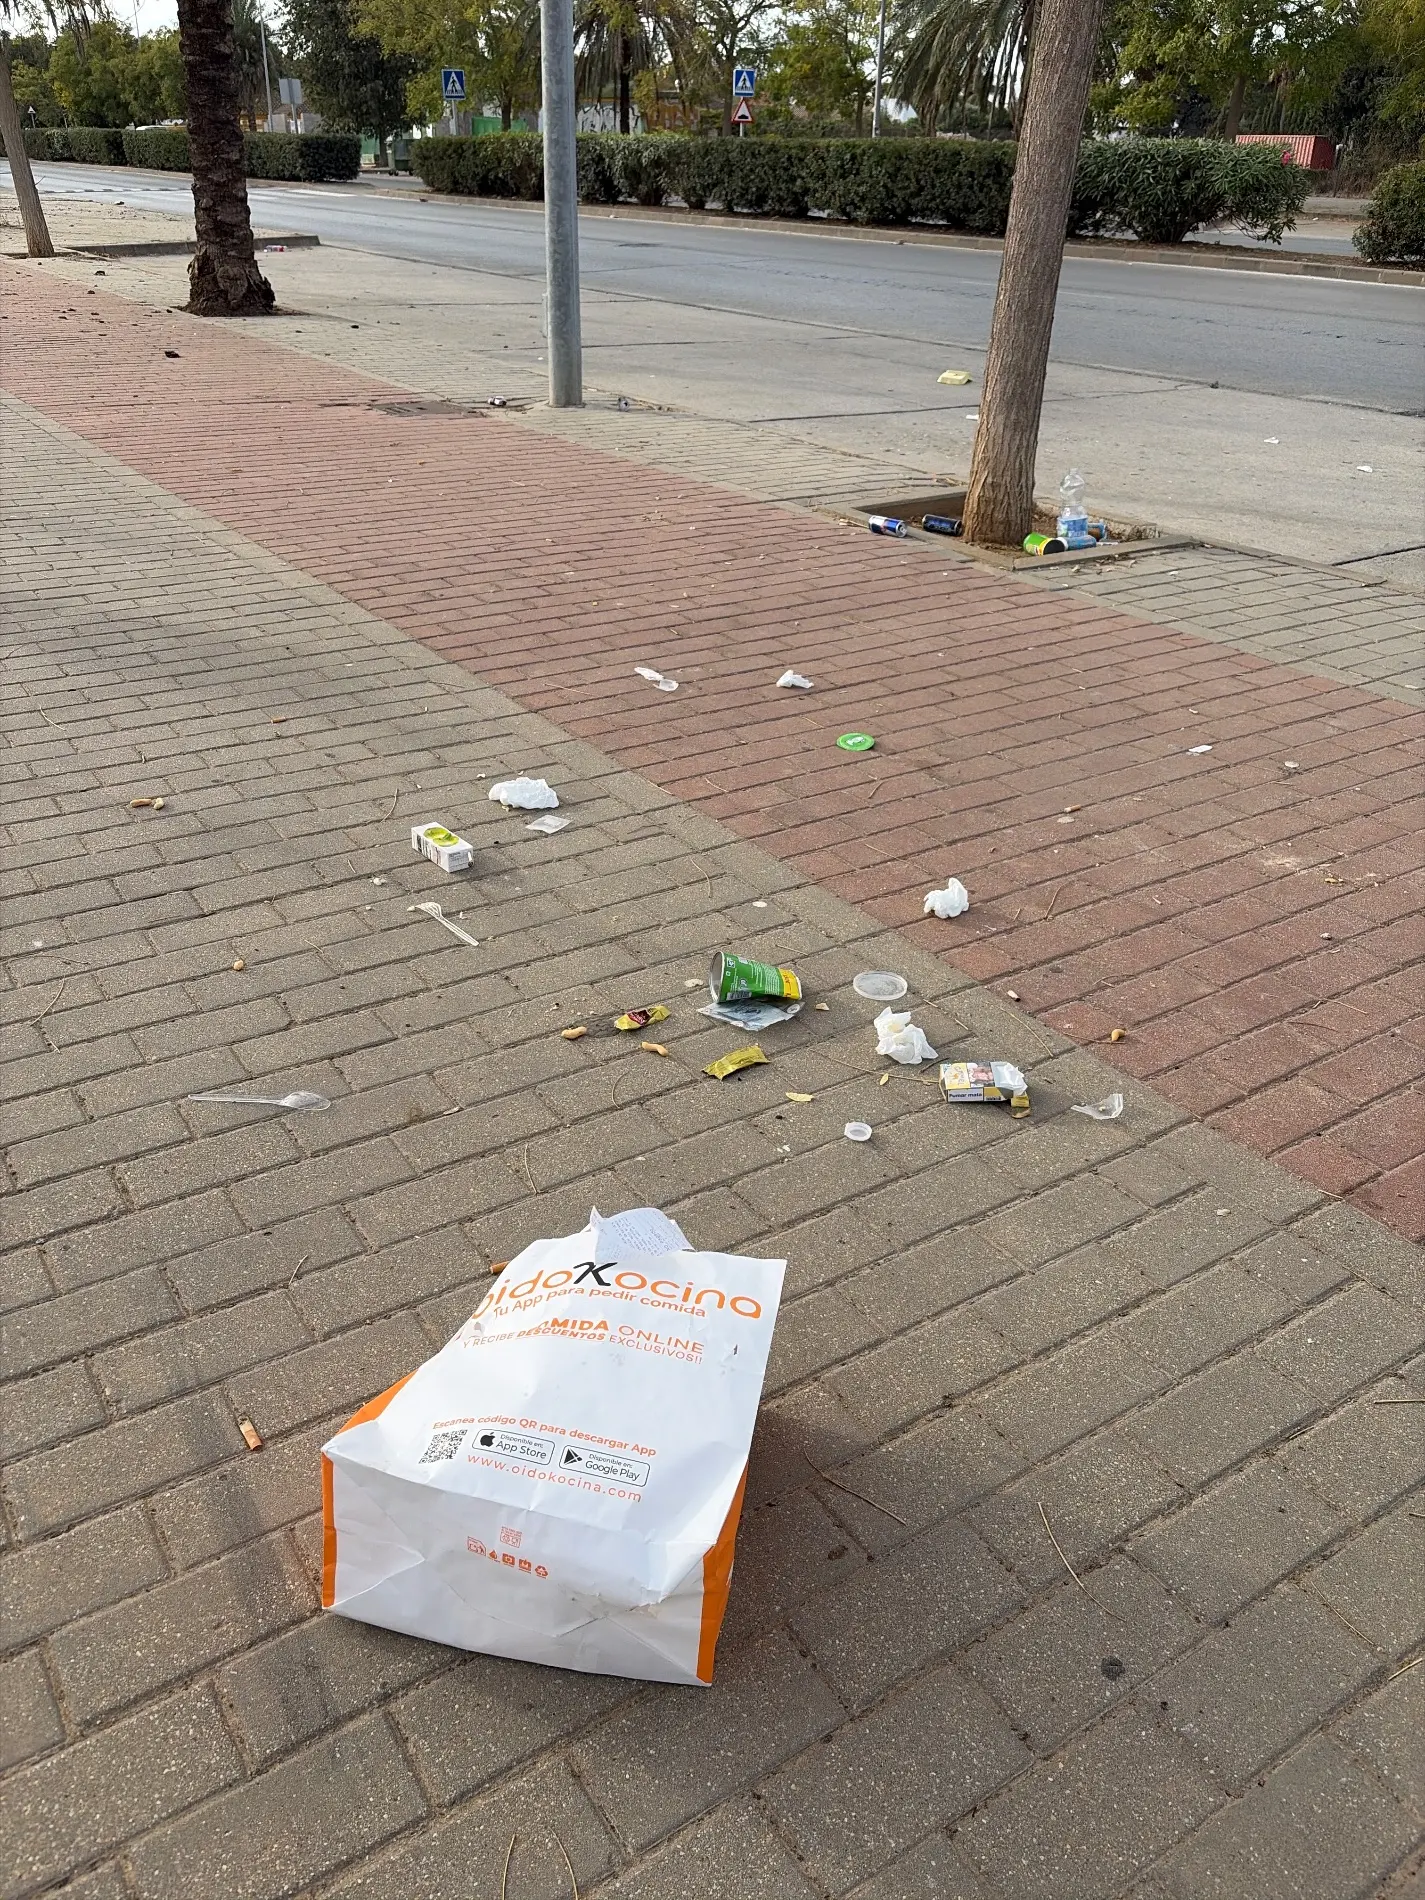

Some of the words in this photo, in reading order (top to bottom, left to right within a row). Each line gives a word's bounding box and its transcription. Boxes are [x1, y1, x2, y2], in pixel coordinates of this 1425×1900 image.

[494, 1305, 509, 1319] Tu
[512, 1294, 543, 1312] App
[546, 1286, 584, 1301] para
[588, 1286, 637, 1302] pedir
[640, 1295, 706, 1318] comida
[463, 1339, 472, 1349] Y
[472, 1331, 514, 1347] RECIBE
[516, 1326, 606, 1342] DESCUENTOS
[609, 1334, 703, 1364] EXCLUSIVOS!!
[618, 1325, 705, 1355] ONLINE
[432, 1416, 475, 1430] Escanea
[478, 1414, 517, 1426] código
[519, 1418, 538, 1431] QR
[539, 1422, 567, 1437] para
[569, 1429, 630, 1450] descargar
[631, 1443, 657, 1458] App
[496, 1440, 518, 1453] App
[520, 1445, 547, 1459] Store
[500, 1433, 532, 1447] Disponible
[585, 1460, 618, 1475] Google
[620, 1468, 641, 1482] Play
[588, 1453, 622, 1467] Disponible
[467, 1454, 642, 1503] www.oidokocina.com
